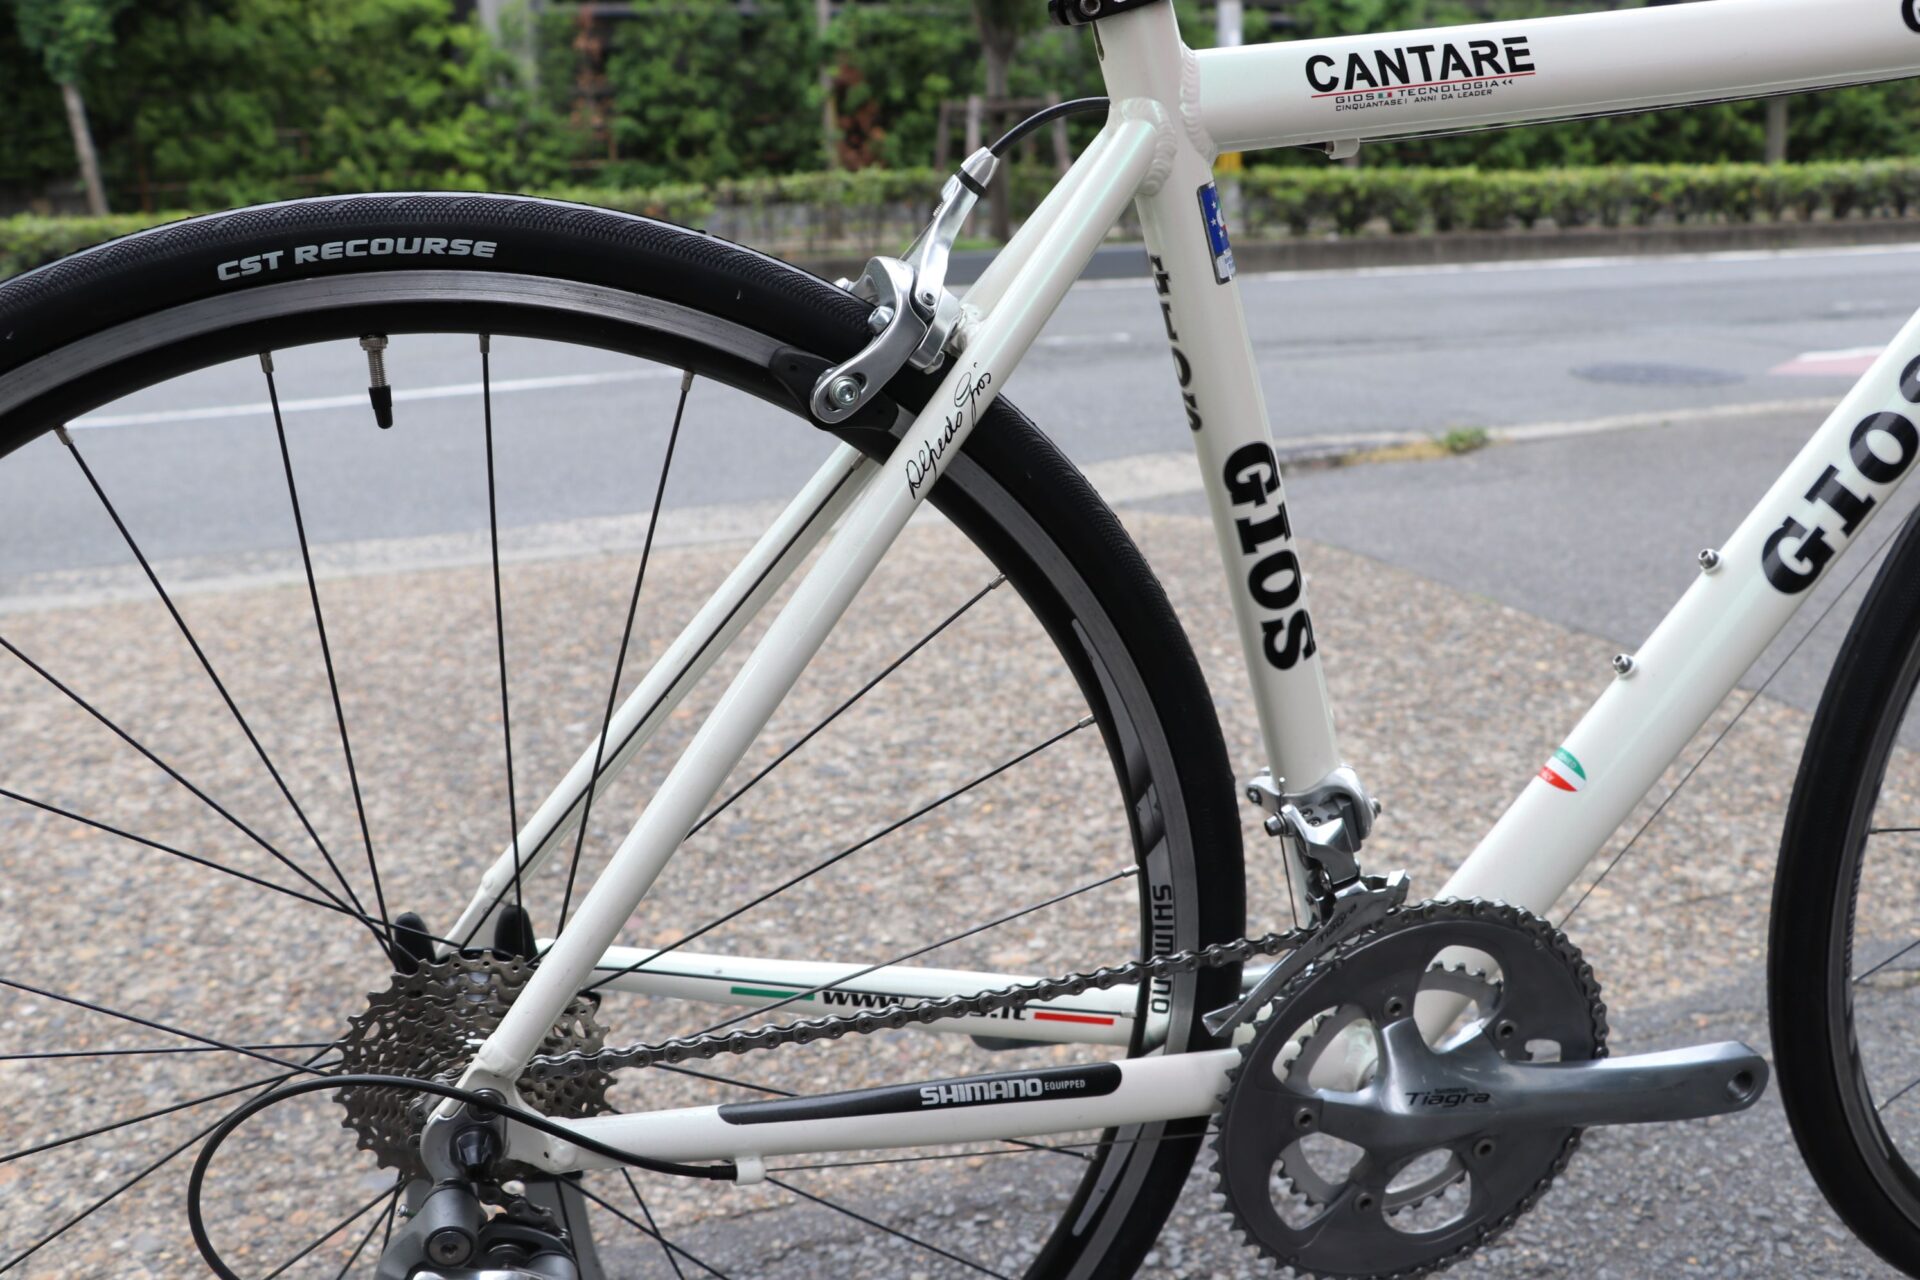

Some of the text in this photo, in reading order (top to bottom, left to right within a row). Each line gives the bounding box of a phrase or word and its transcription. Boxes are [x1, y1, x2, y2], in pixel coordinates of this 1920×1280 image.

[1305, 36, 1535, 92] CANTARE
[1335, 80, 1499, 104] GIOS TECNOLOGIA
[1335, 98, 1408, 111] CINQUANTASEI
[1414, 95, 1437, 104] ANNI
[1457, 89, 1493, 99] LEADER
[217, 237, 497, 281] CST RECOURSE
[1222, 441, 1316, 671] GIOS
[1151, 884, 1174, 1014] SHIMNO
[920, 1078, 1086, 1105] SHIMANO EQUIPPED
[1405, 1092, 1491, 1108] Tiagra
